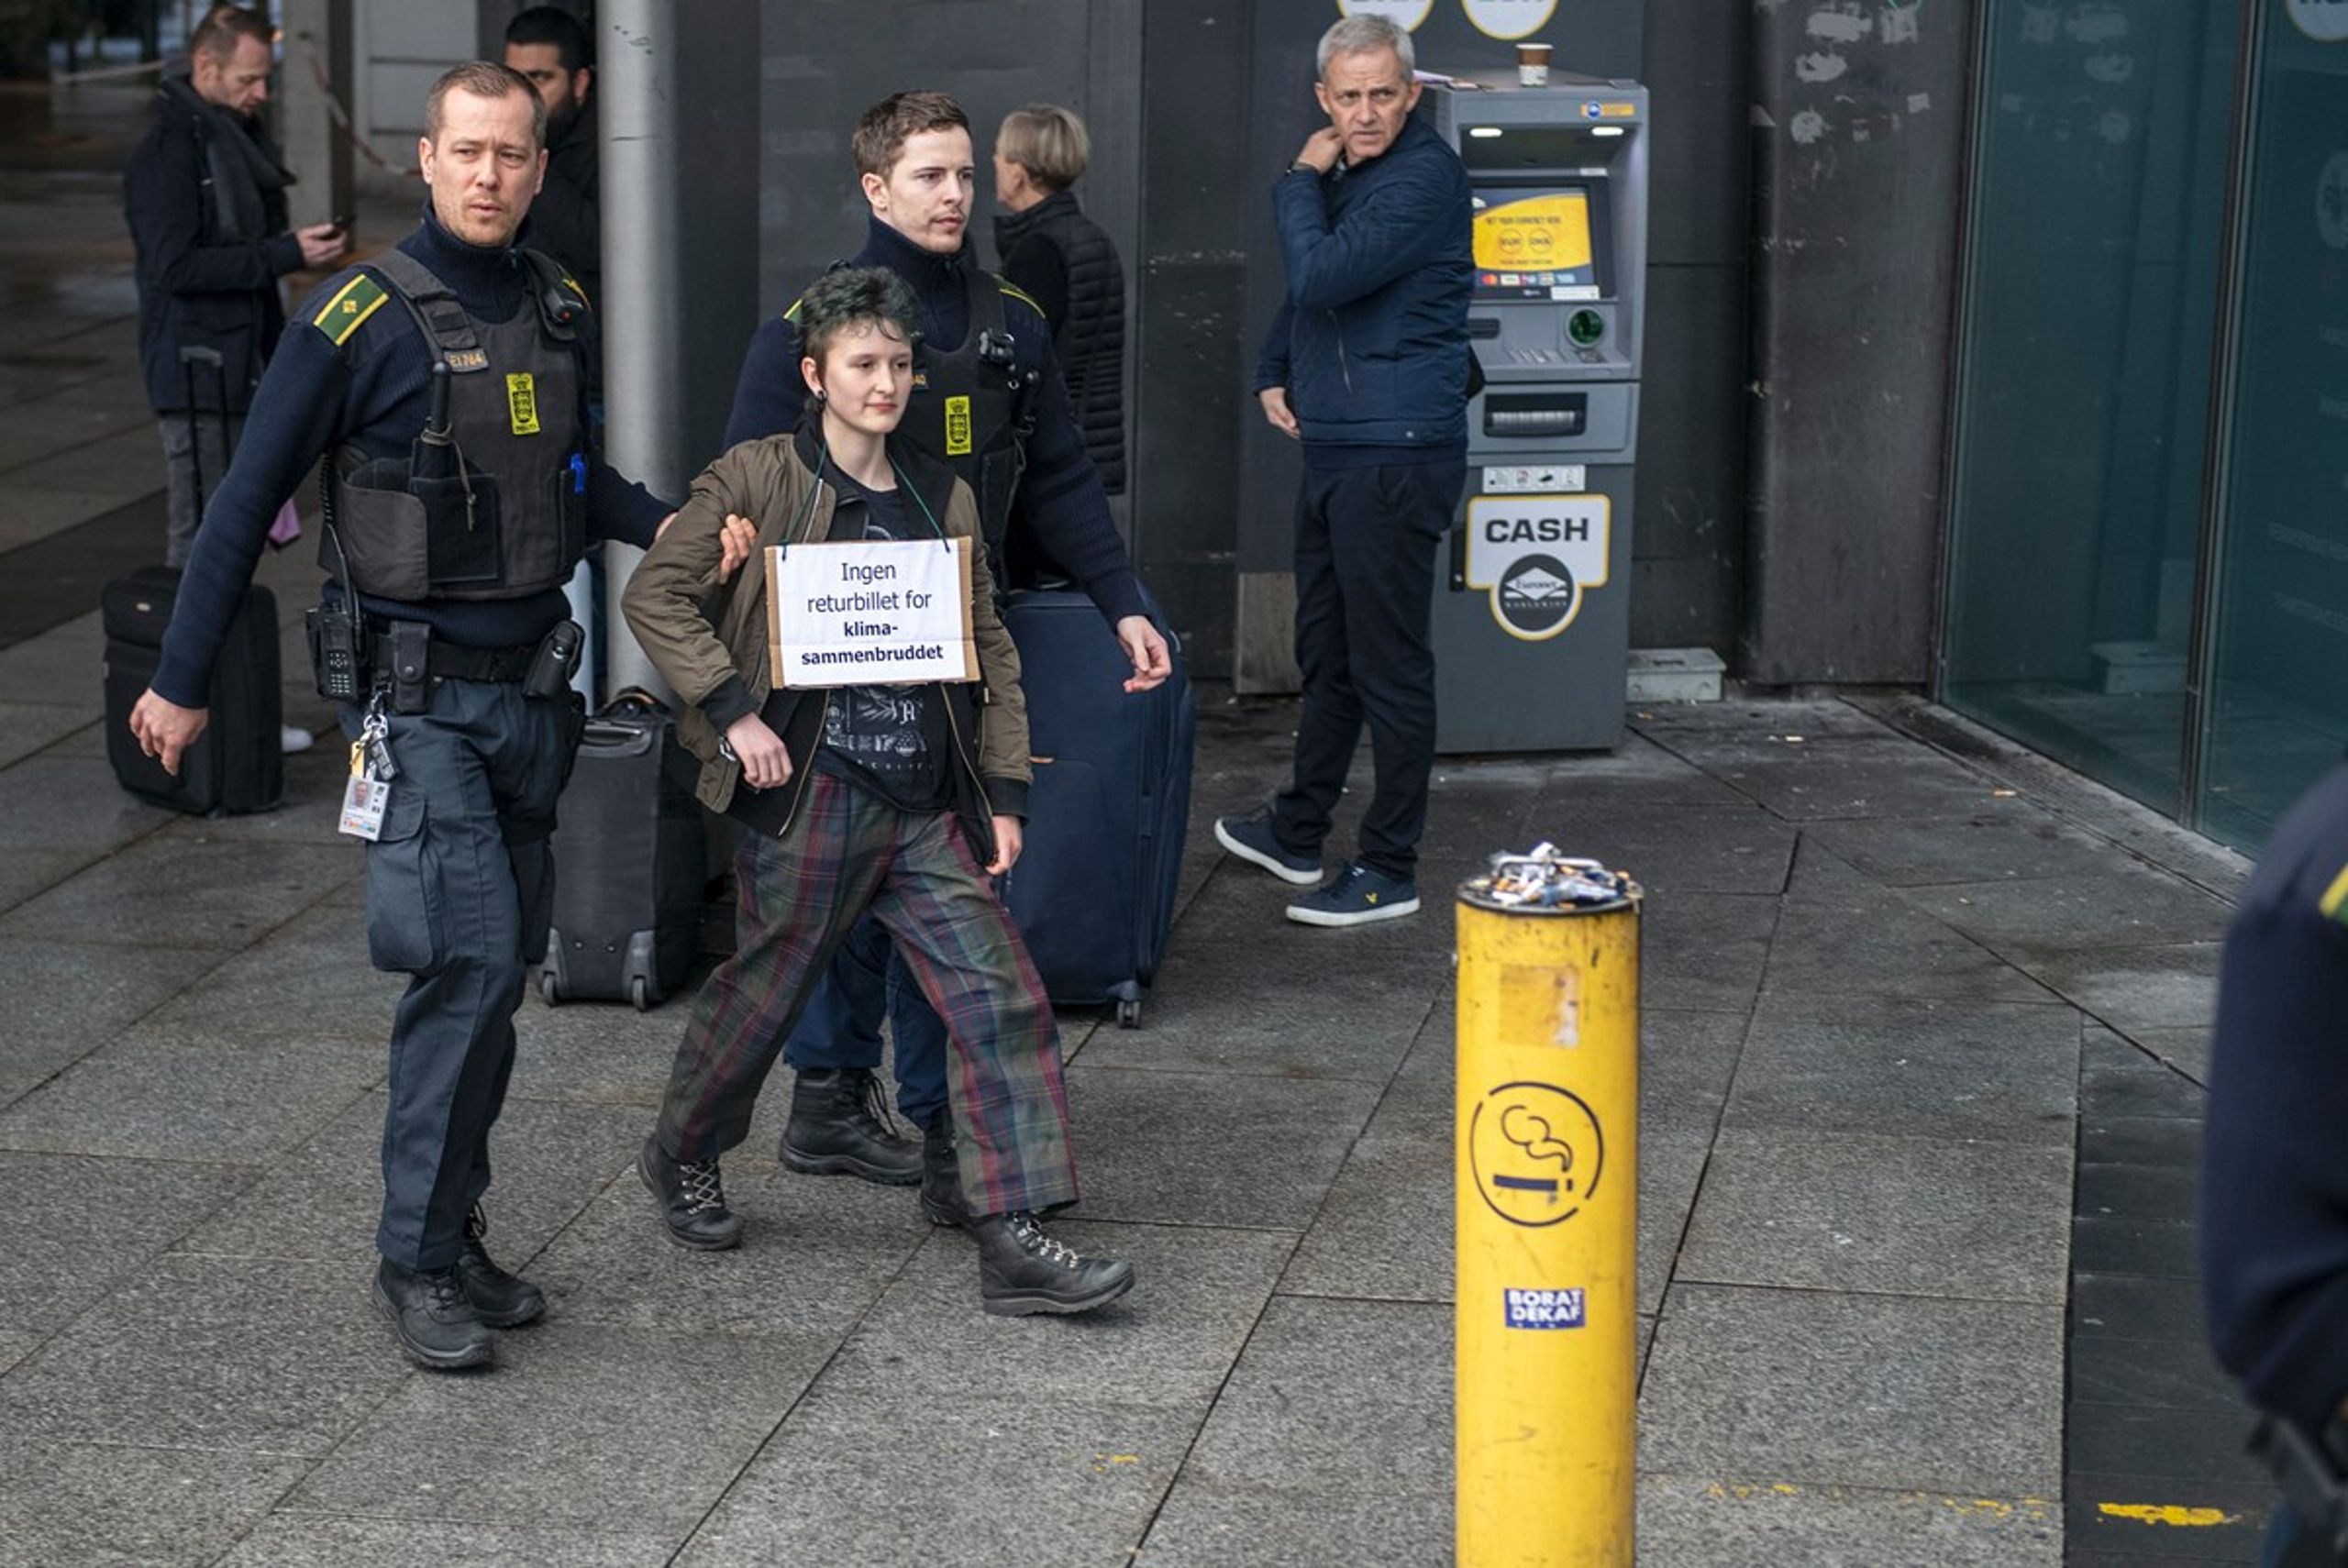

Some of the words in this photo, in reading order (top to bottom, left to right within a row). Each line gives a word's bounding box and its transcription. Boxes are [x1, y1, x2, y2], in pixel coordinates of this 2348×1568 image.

[1485, 518, 1589, 543] CASH
[841, 562, 896, 585] Ingen
[807, 591, 900, 613] returbillet
[905, 590, 932, 609] for
[844, 621, 899, 637] klima-
[802, 645, 944, 665] sammenbruddet
[1508, 1289, 1582, 1306] BORAT
